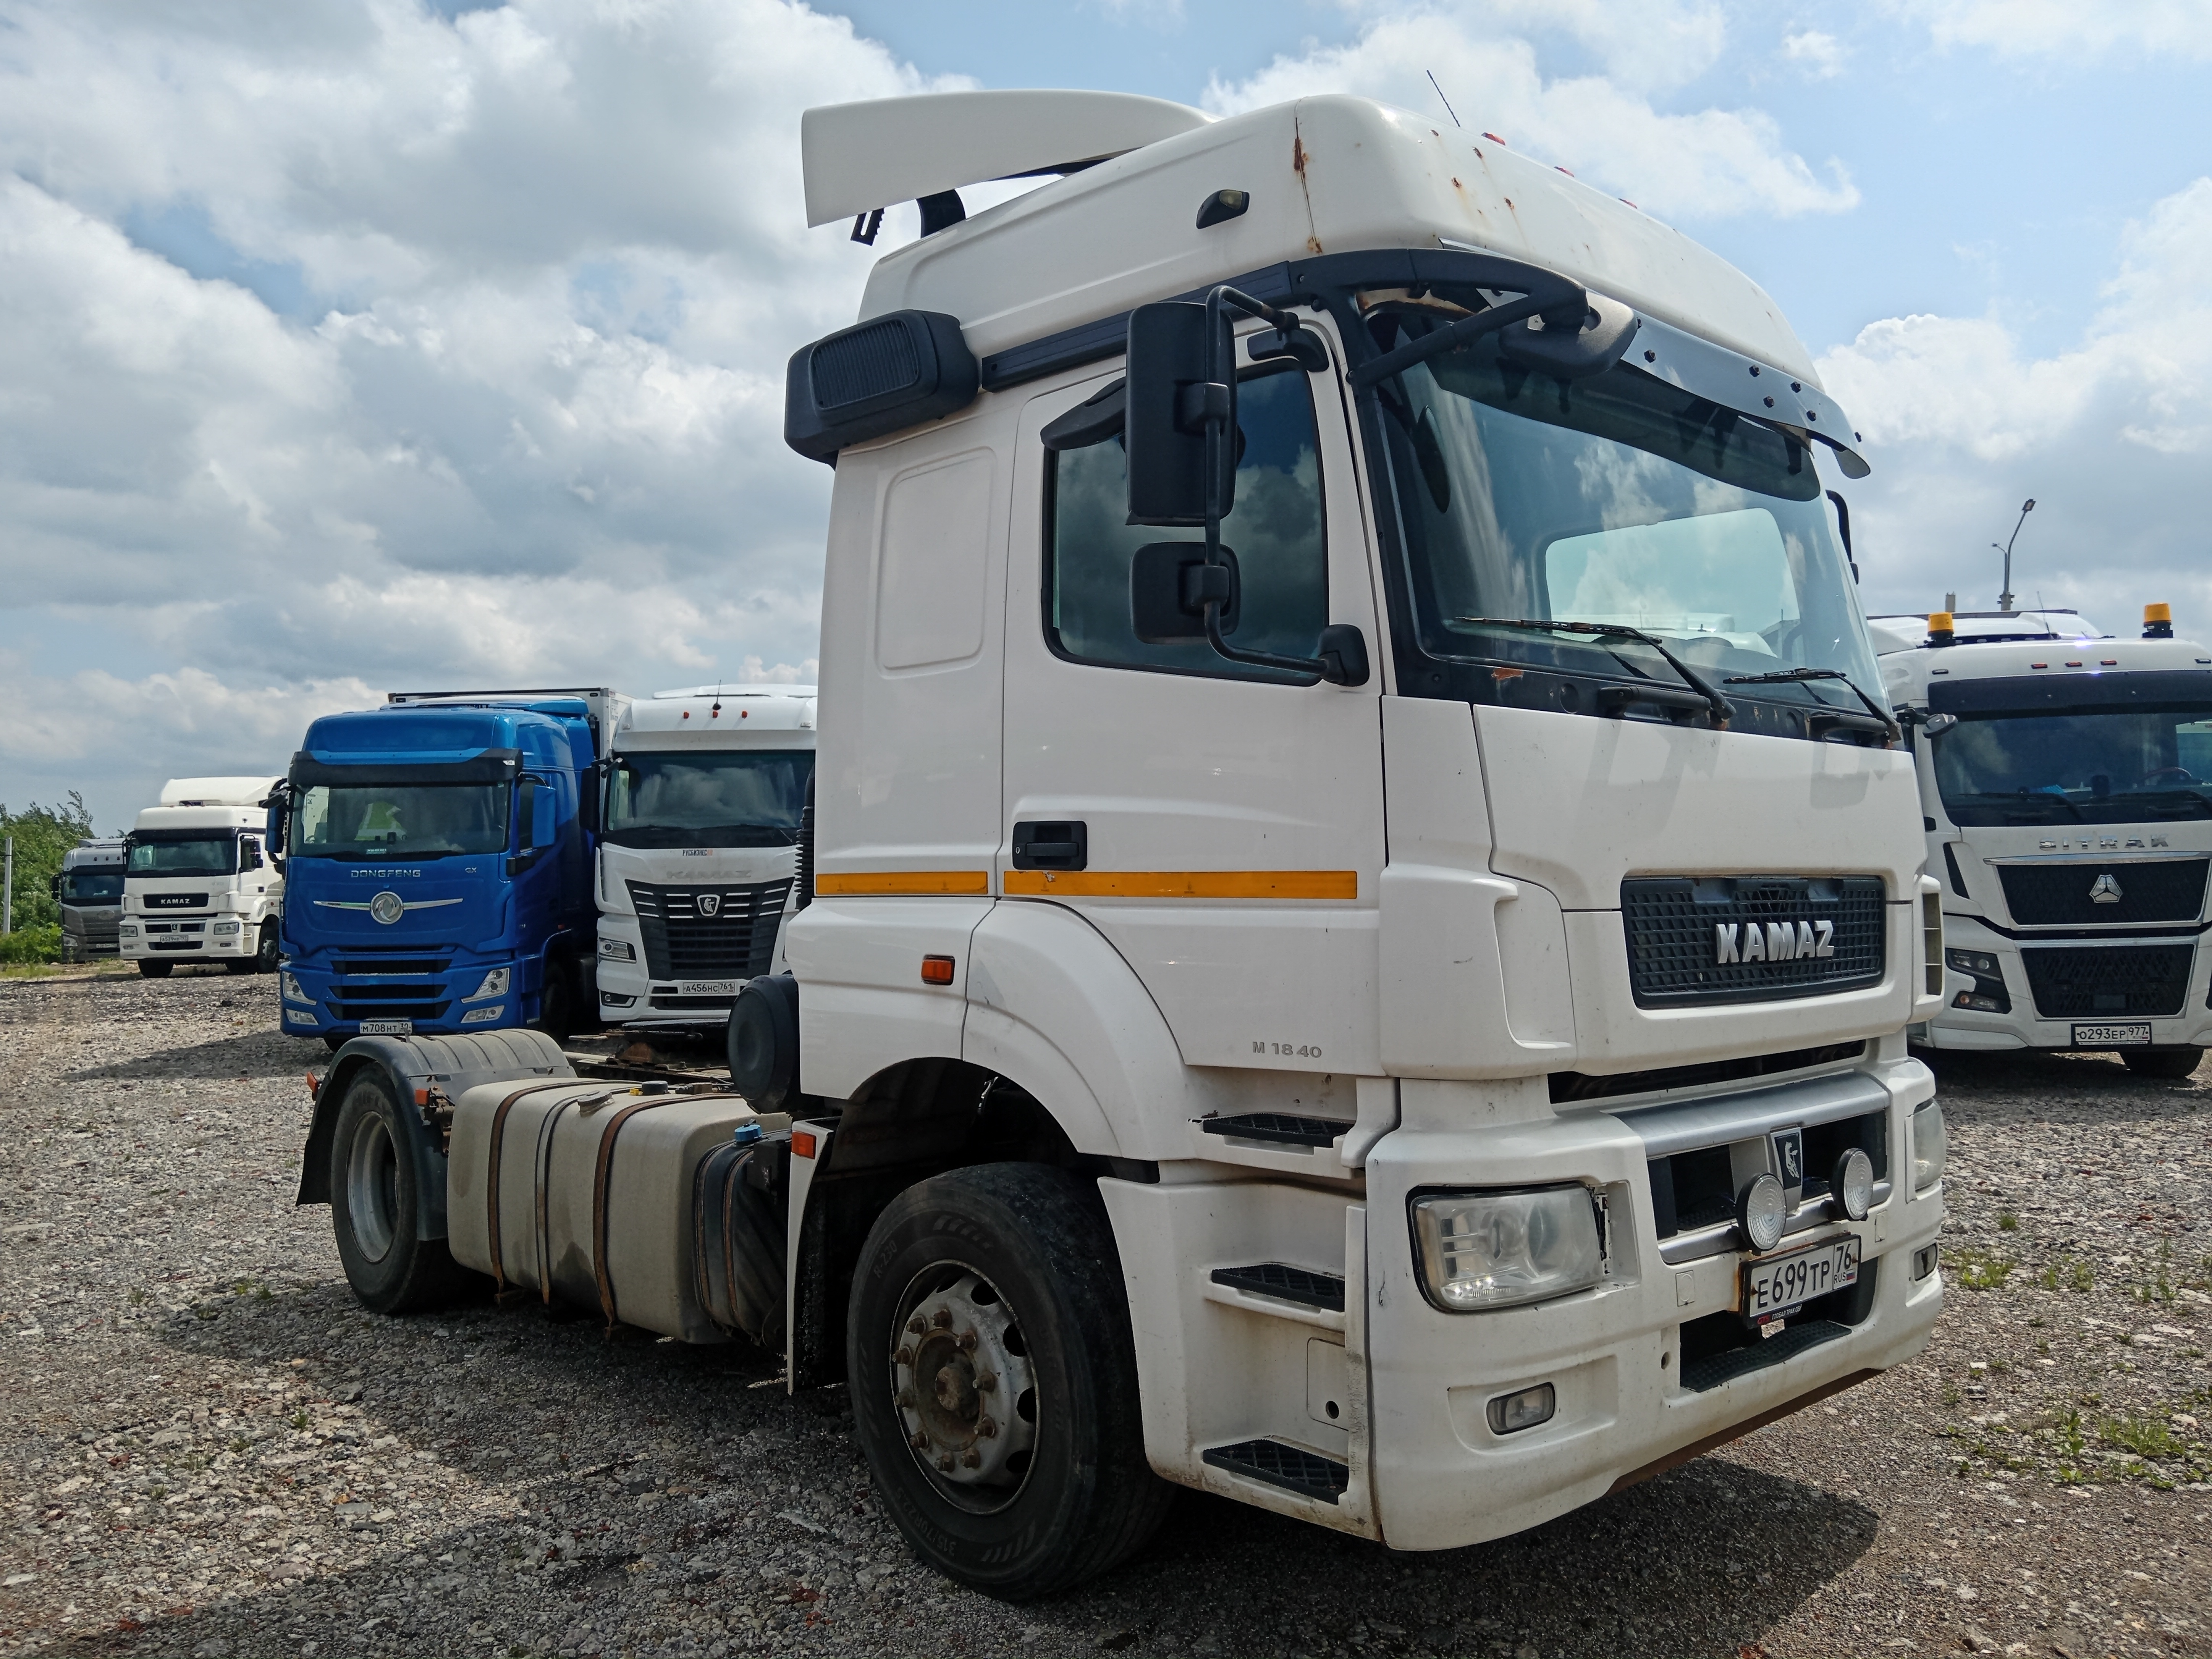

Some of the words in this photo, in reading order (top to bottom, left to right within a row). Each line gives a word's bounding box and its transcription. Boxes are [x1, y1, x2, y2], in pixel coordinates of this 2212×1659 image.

[2039, 834, 2168, 851] SITRAK
[351, 870, 421, 878] DONGFENG
[1715, 920, 1834, 964] KAMAZ
[686, 984, 718, 992] А456НС
[363, 1024, 397, 1032] М708НТ
[2128, 1027, 2146, 1036] 977
[1252, 1041, 1265, 1054] M
[1271, 1043, 1322, 1058] 1840
[1758, 1260, 1830, 1309] Е699ТР
[1836, 1243, 1852, 1273] 76
[1834, 1272, 1846, 1284] RUS
